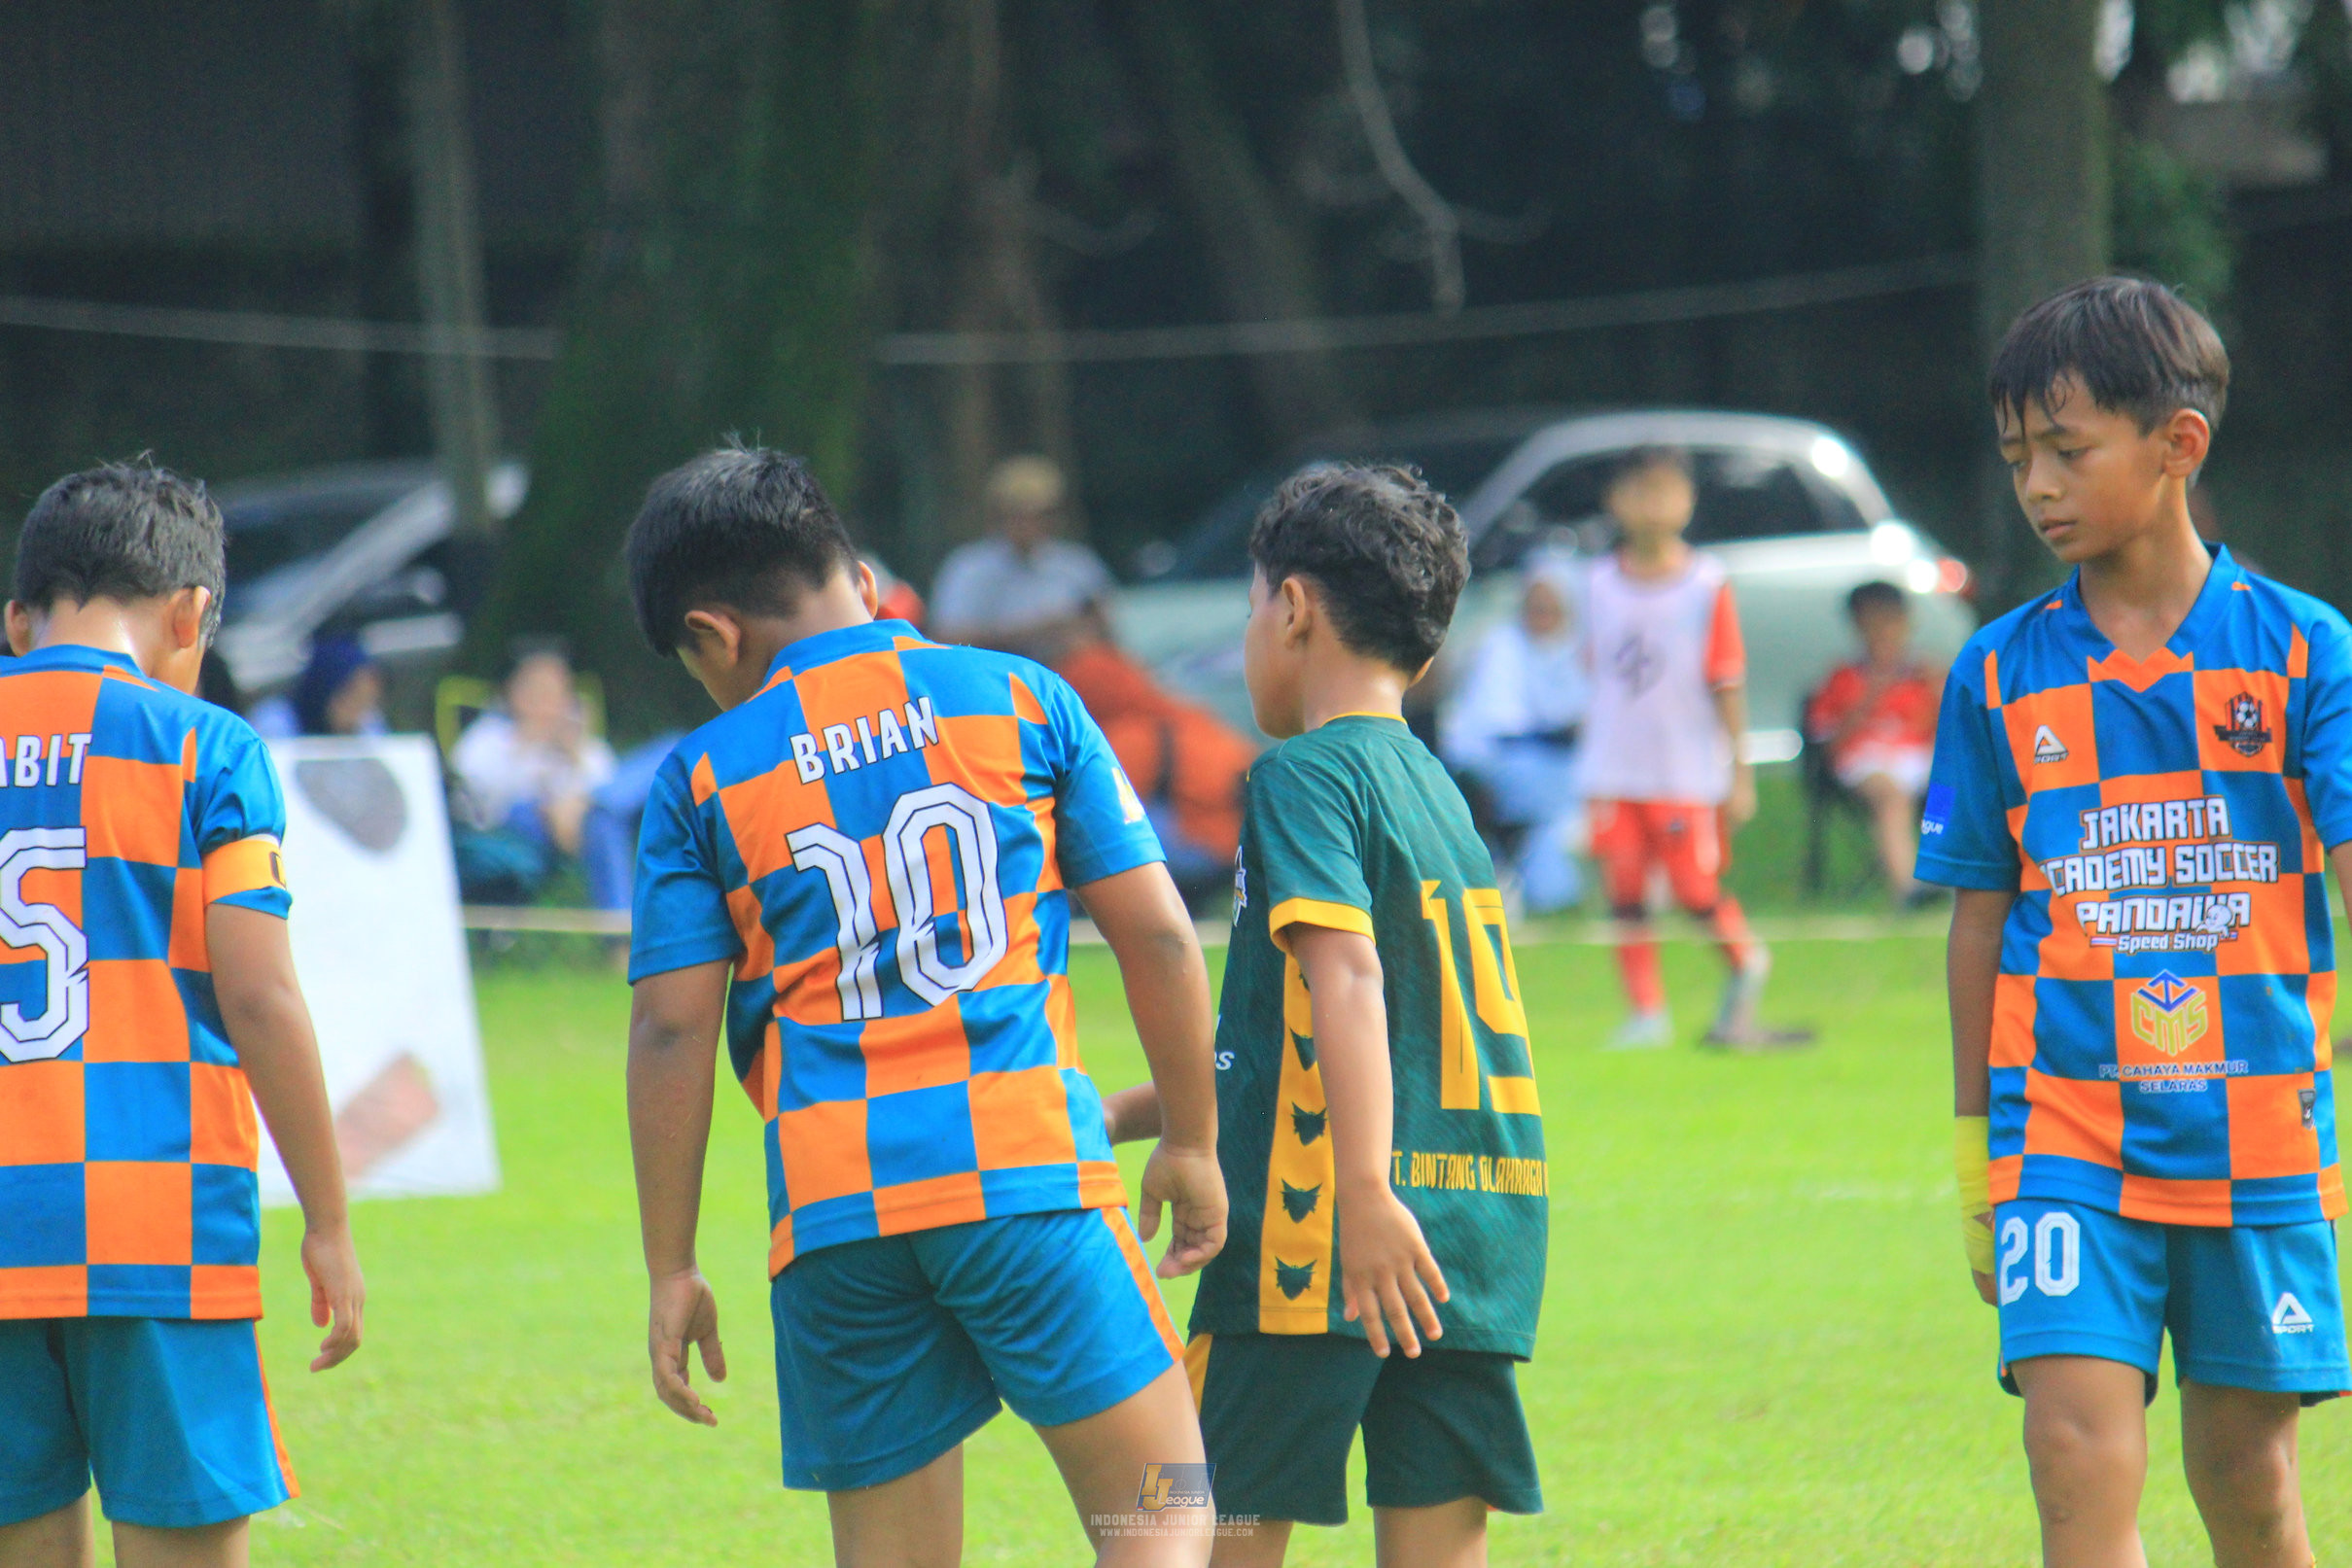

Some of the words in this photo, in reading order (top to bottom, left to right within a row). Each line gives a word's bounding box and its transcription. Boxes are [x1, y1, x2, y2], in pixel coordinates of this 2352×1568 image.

[790, 696, 939, 784] BRIAN
[2082, 796, 2230, 851] JAKARTA
[2039, 846, 2167, 897] CADEMY
[2174, 842, 2279, 885] SOCCER
[785, 782, 1008, 1021] 10
[0, 825, 89, 1063] 5
[2118, 934, 2169, 955] Speed
[2173, 930, 2220, 953] Shop
[1421, 879, 1542, 1117] 19
[2130, 991, 2209, 1058] CMS
[2122, 1063, 2181, 1078] CAHAYA
[2183, 1060, 2249, 1076] MAKMUR
[2139, 1078, 2208, 1094] SELARAS
[1411, 1151, 1477, 1191] BINTANG
[1999, 1211, 2081, 1307] 20
